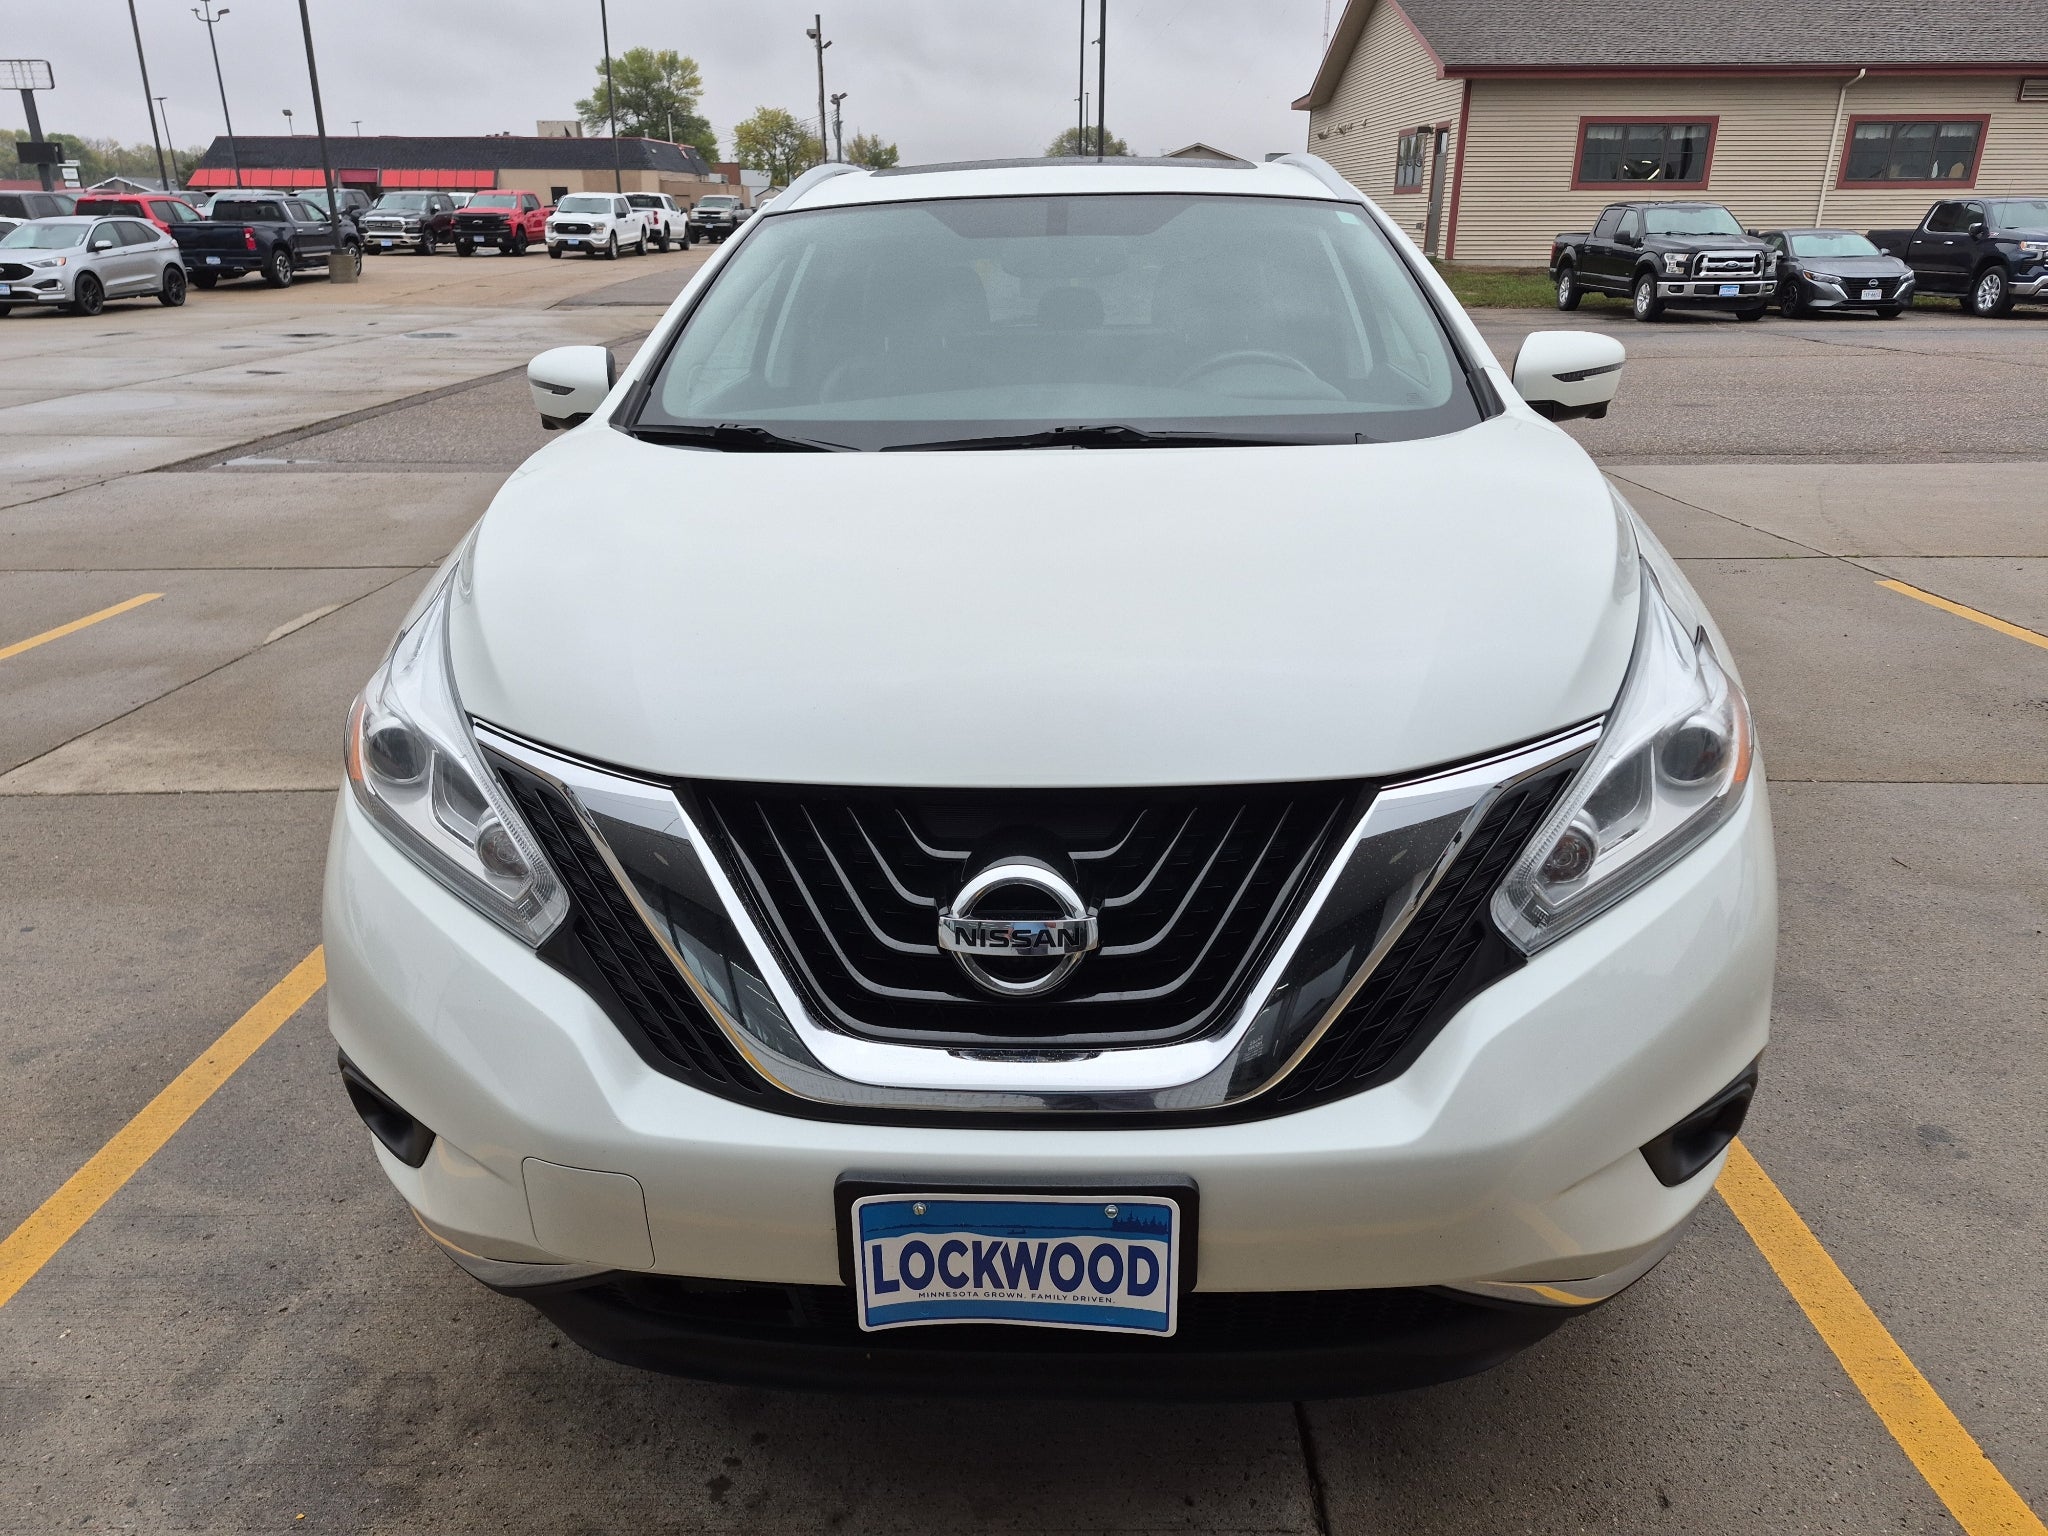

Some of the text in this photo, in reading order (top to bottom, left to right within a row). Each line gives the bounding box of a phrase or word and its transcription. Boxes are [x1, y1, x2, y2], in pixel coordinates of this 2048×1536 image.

[955, 927, 1080, 948] NISSAN
[872, 1239, 1160, 1297] LOCKWOOD
[918, 1291, 1116, 1304] MINNESOTA GROWN. FAMILY DRIVEN.
